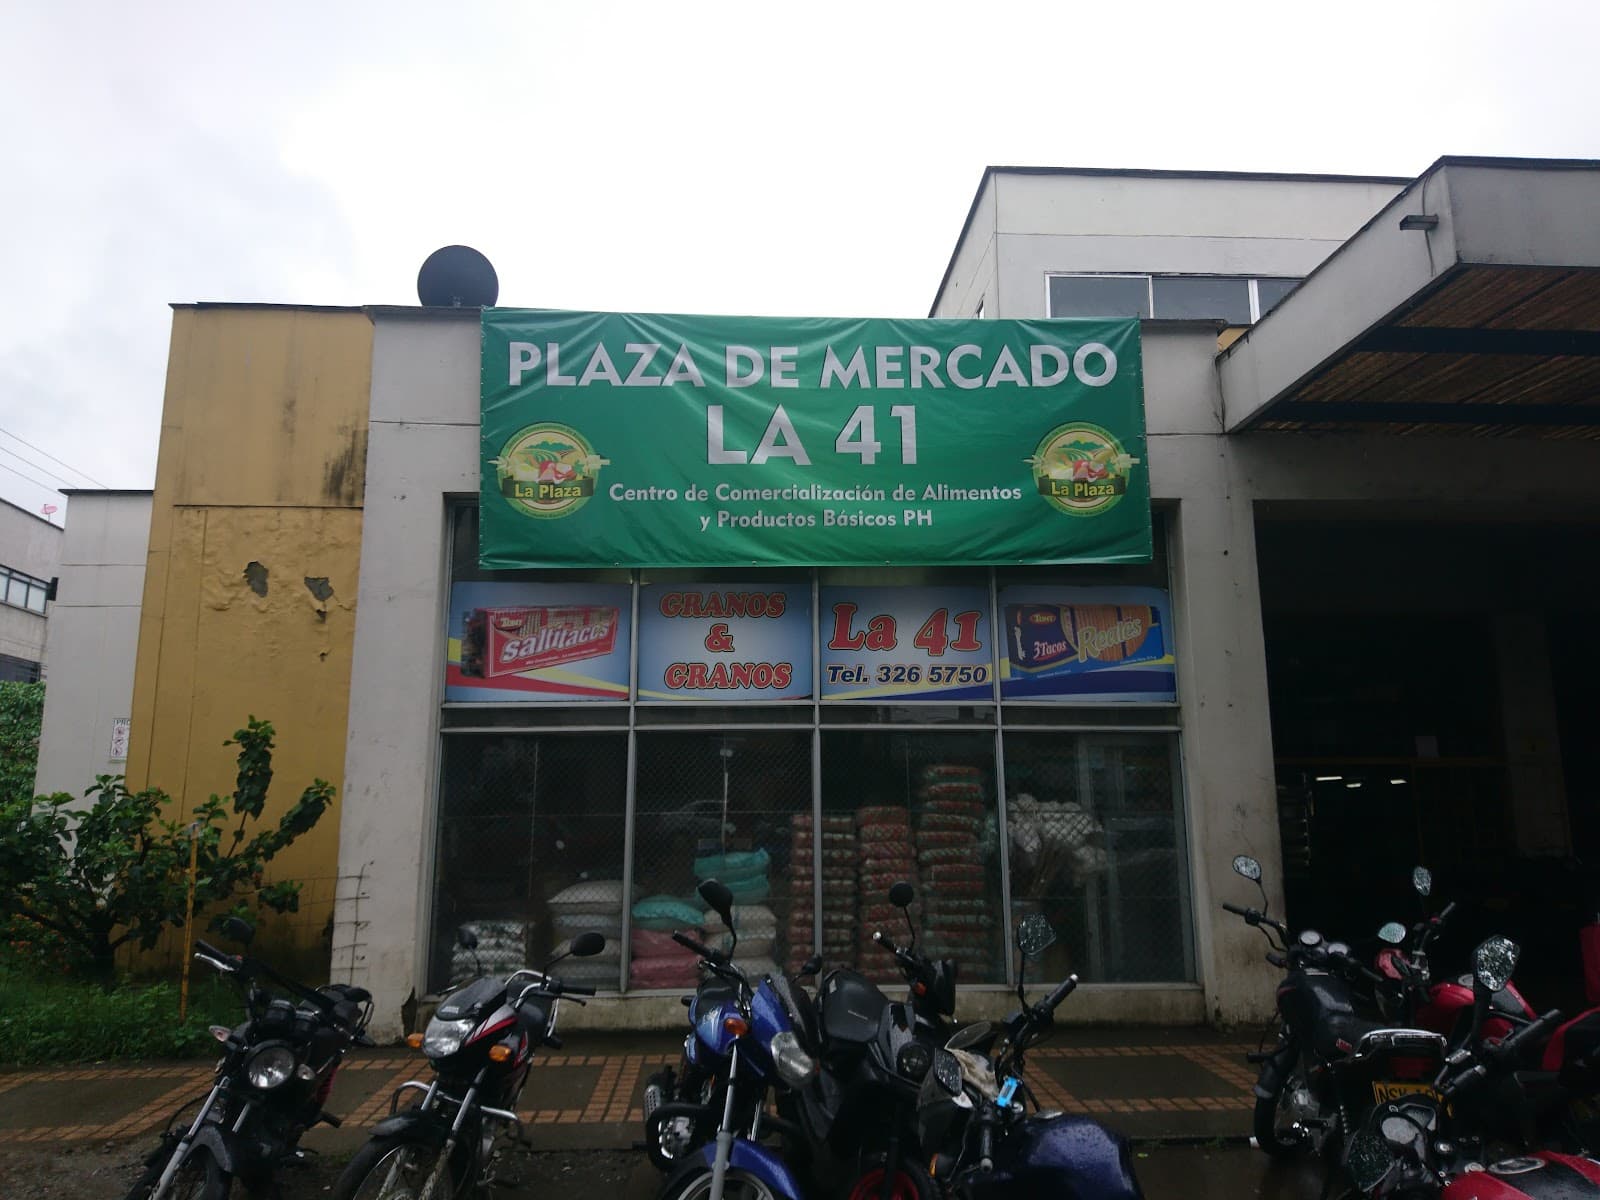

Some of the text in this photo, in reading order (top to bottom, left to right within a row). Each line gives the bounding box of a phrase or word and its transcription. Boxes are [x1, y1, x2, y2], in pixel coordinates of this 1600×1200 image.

[509, 341, 1118, 390] PLAZA DE MERCADO
[706, 403, 918, 466] LA 41
[514, 483, 582, 499] La Plaza
[609, 483, 1022, 502] Centro de Comercialización de Alimentos
[1051, 481, 1115, 497] La Plaza
[699, 509, 933, 532] y Productos Básicos PH
[660, 591, 787, 618] GRANOS
[705, 623, 735, 653] &
[828, 602, 983, 657] La 41
[664, 662, 793, 689] GRANOS
[826, 664, 989, 685] Tel. 326 5750
